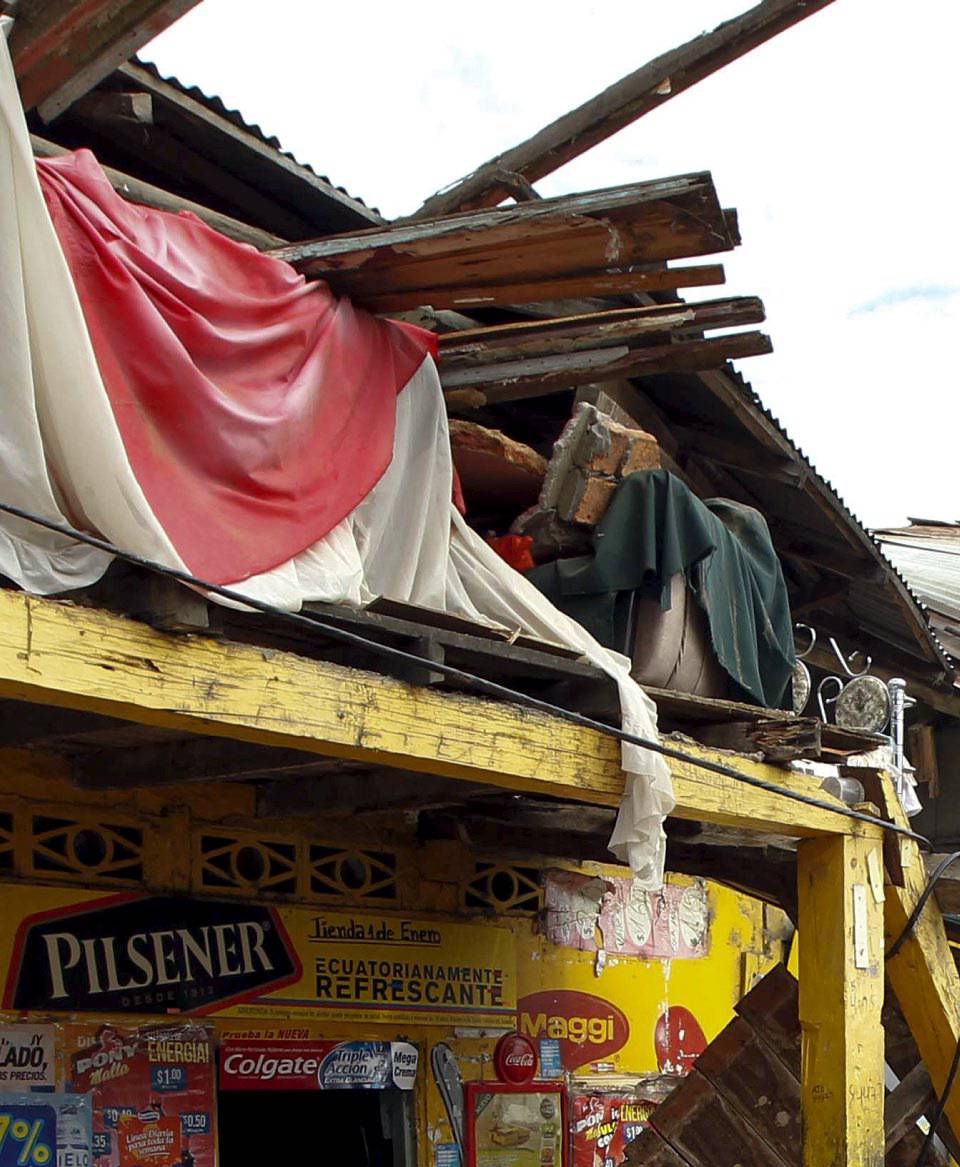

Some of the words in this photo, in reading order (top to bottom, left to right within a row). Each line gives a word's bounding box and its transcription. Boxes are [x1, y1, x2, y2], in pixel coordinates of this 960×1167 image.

[308, 917, 364, 940] Tienda
[376, 921, 394, 941] de
[400, 921, 441, 943] Enero
[43, 921, 275, 998] PILSENER
[316, 958, 503, 984] ECUATORIANAMENTE
[316, 976, 503, 1006] REFRESCANTE
[277, 1029, 310, 1039] NUEVA
[520, 1014, 614, 1044] Maggi
[223, 1053, 318, 1080] Colgate
[335, 1048, 369, 1064] Triple
[394, 1052, 417, 1066] Mega
[394, 1067, 416, 1077] Crema
